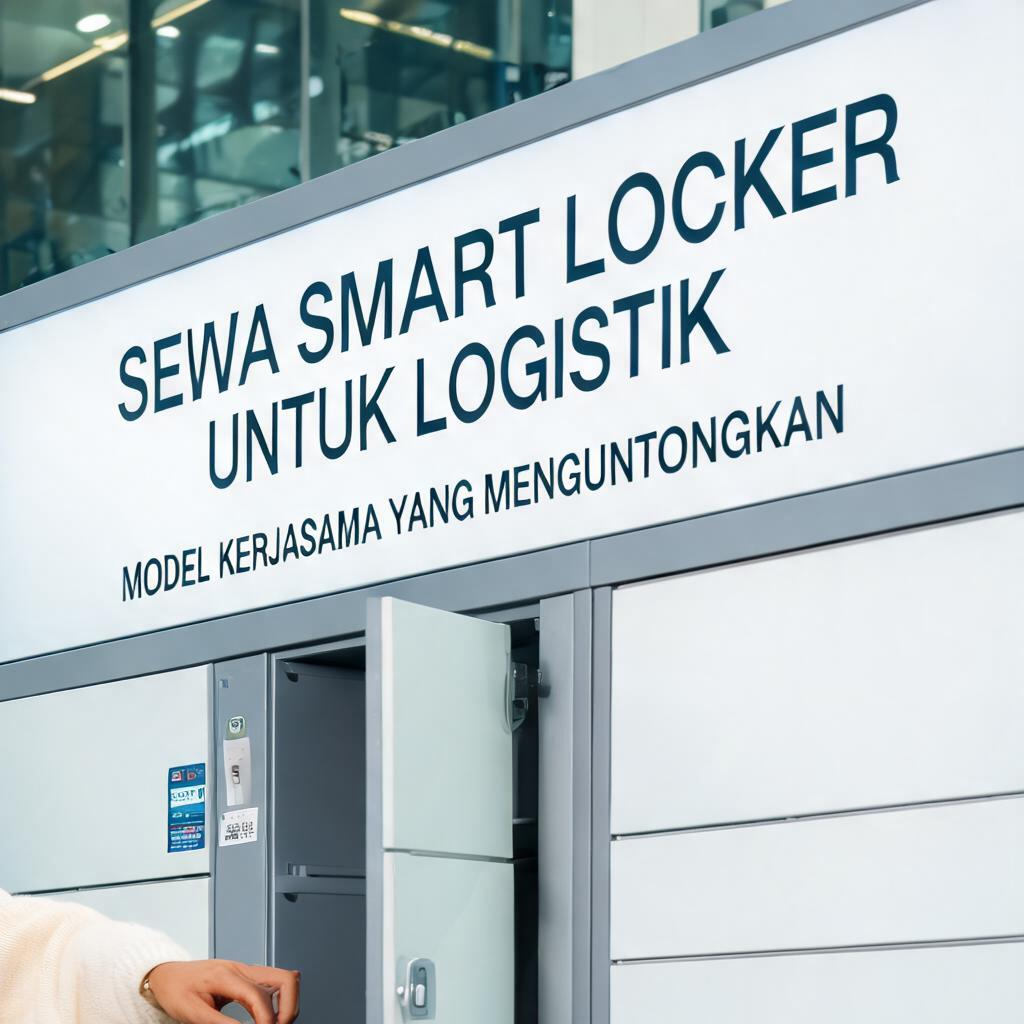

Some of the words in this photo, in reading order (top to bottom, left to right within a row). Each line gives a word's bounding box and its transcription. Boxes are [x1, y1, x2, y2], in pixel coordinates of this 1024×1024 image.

[117, 303, 280, 422] SEWA
[297, 207, 541, 364] SMART
[566, 93, 901, 284] LOCKER
[209, 365, 397, 490] UNTUK
[416, 267, 731, 437] LOGISTIK
[122, 546, 211, 602] MODEL
[219, 503, 383, 579] KERJASAMA
[388, 479, 474, 535] YANG
[484, 384, 844, 515] MENGUNTONGKAN
